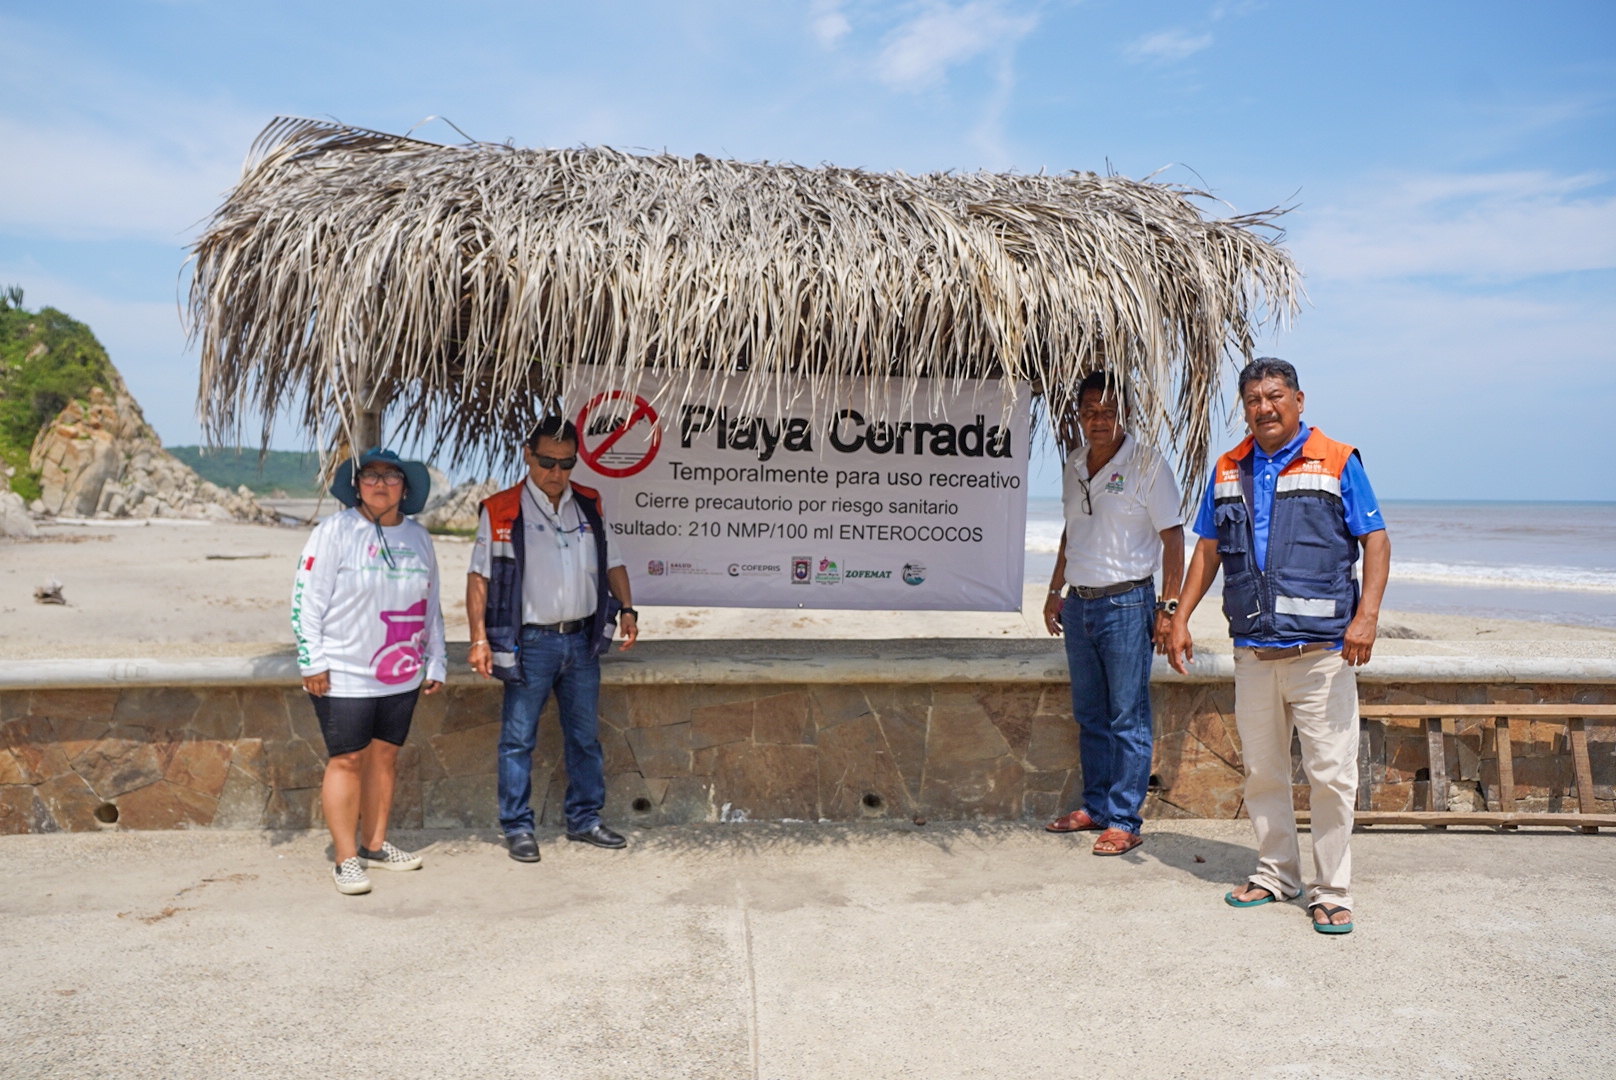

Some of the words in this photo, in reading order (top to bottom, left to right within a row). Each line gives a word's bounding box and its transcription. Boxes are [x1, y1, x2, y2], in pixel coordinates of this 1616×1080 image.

[681, 404, 814, 462] Playa
[828, 408, 1013, 459] Cerrada
[669, 462, 828, 485] Temporalmente
[836, 470, 880, 488] para
[887, 472, 922, 487] uso
[929, 471, 1020, 489] recreativo
[635, 492, 689, 509] Cierre
[695, 496, 792, 512] precautorio
[799, 499, 826, 515] por
[832, 497, 883, 517] riesgo
[888, 499, 958, 515] sanitario
[609, 520, 682, 537] sultado:
[688, 521, 721, 537] 210
[727, 522, 807, 539] NMP/100
[813, 524, 833, 539] ml
[839, 525, 983, 542] ENTEROCOCOS
[741, 564, 781, 572] COFEPRIS
[845, 570, 892, 578] ZOFEMAT
